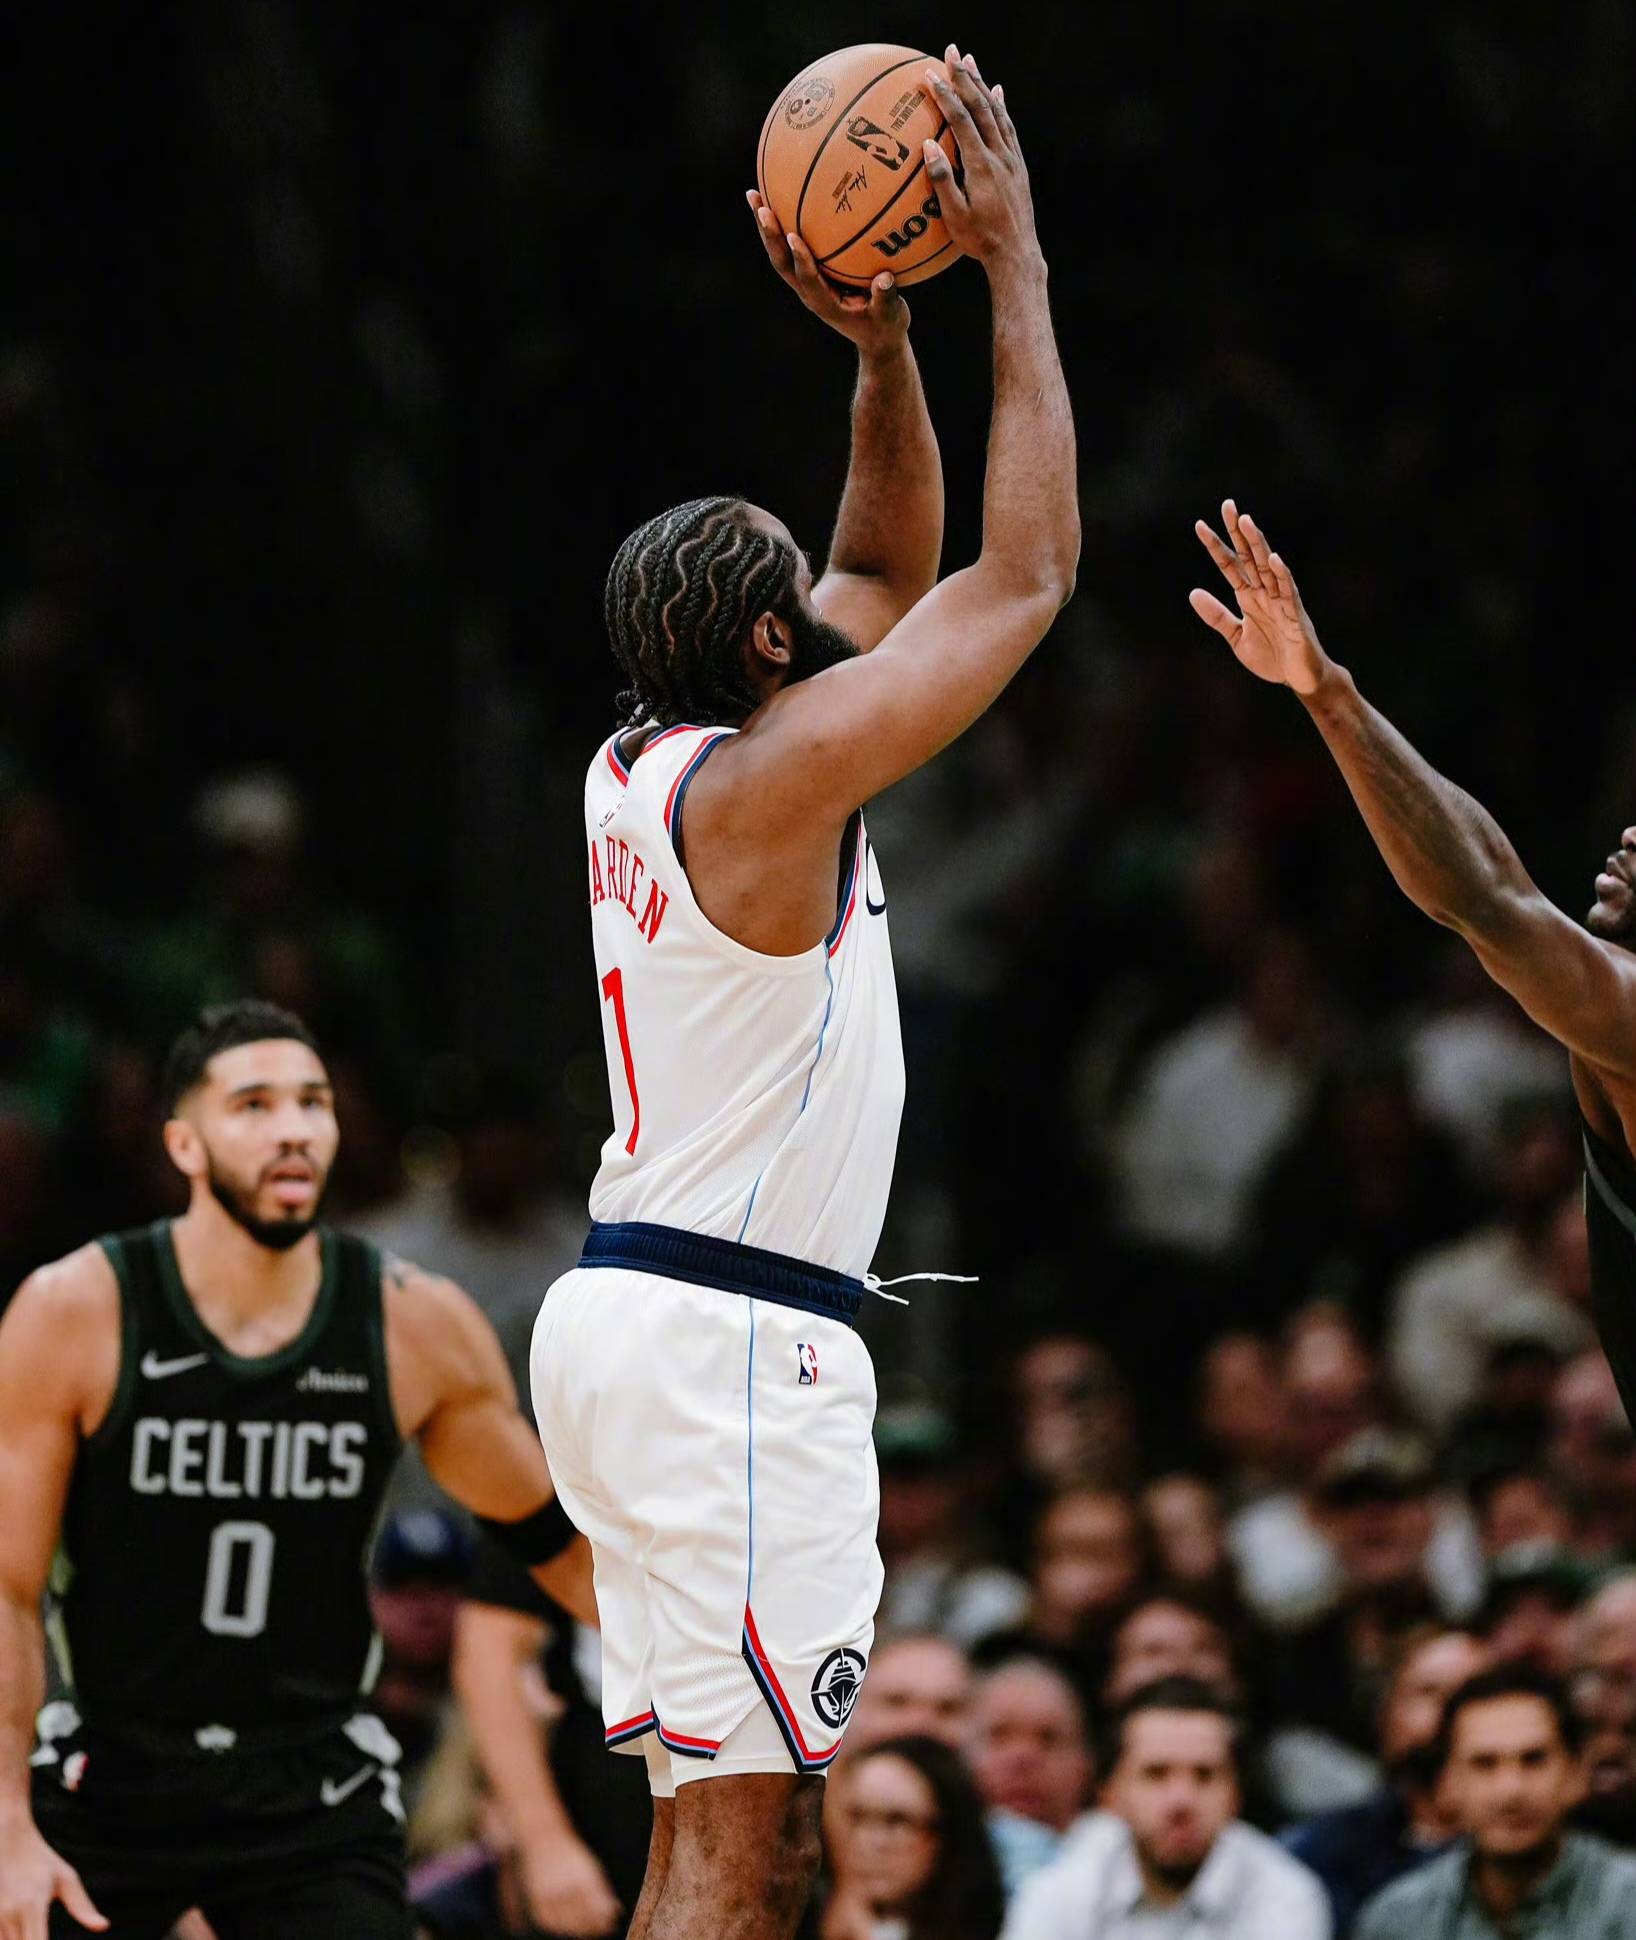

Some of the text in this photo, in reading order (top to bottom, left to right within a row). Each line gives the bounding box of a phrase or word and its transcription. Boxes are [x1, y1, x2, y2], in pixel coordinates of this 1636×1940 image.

[601, 966, 640, 1156] 1
[130, 1417, 367, 1499] CELTICS
[202, 1520, 275, 1637] 0
